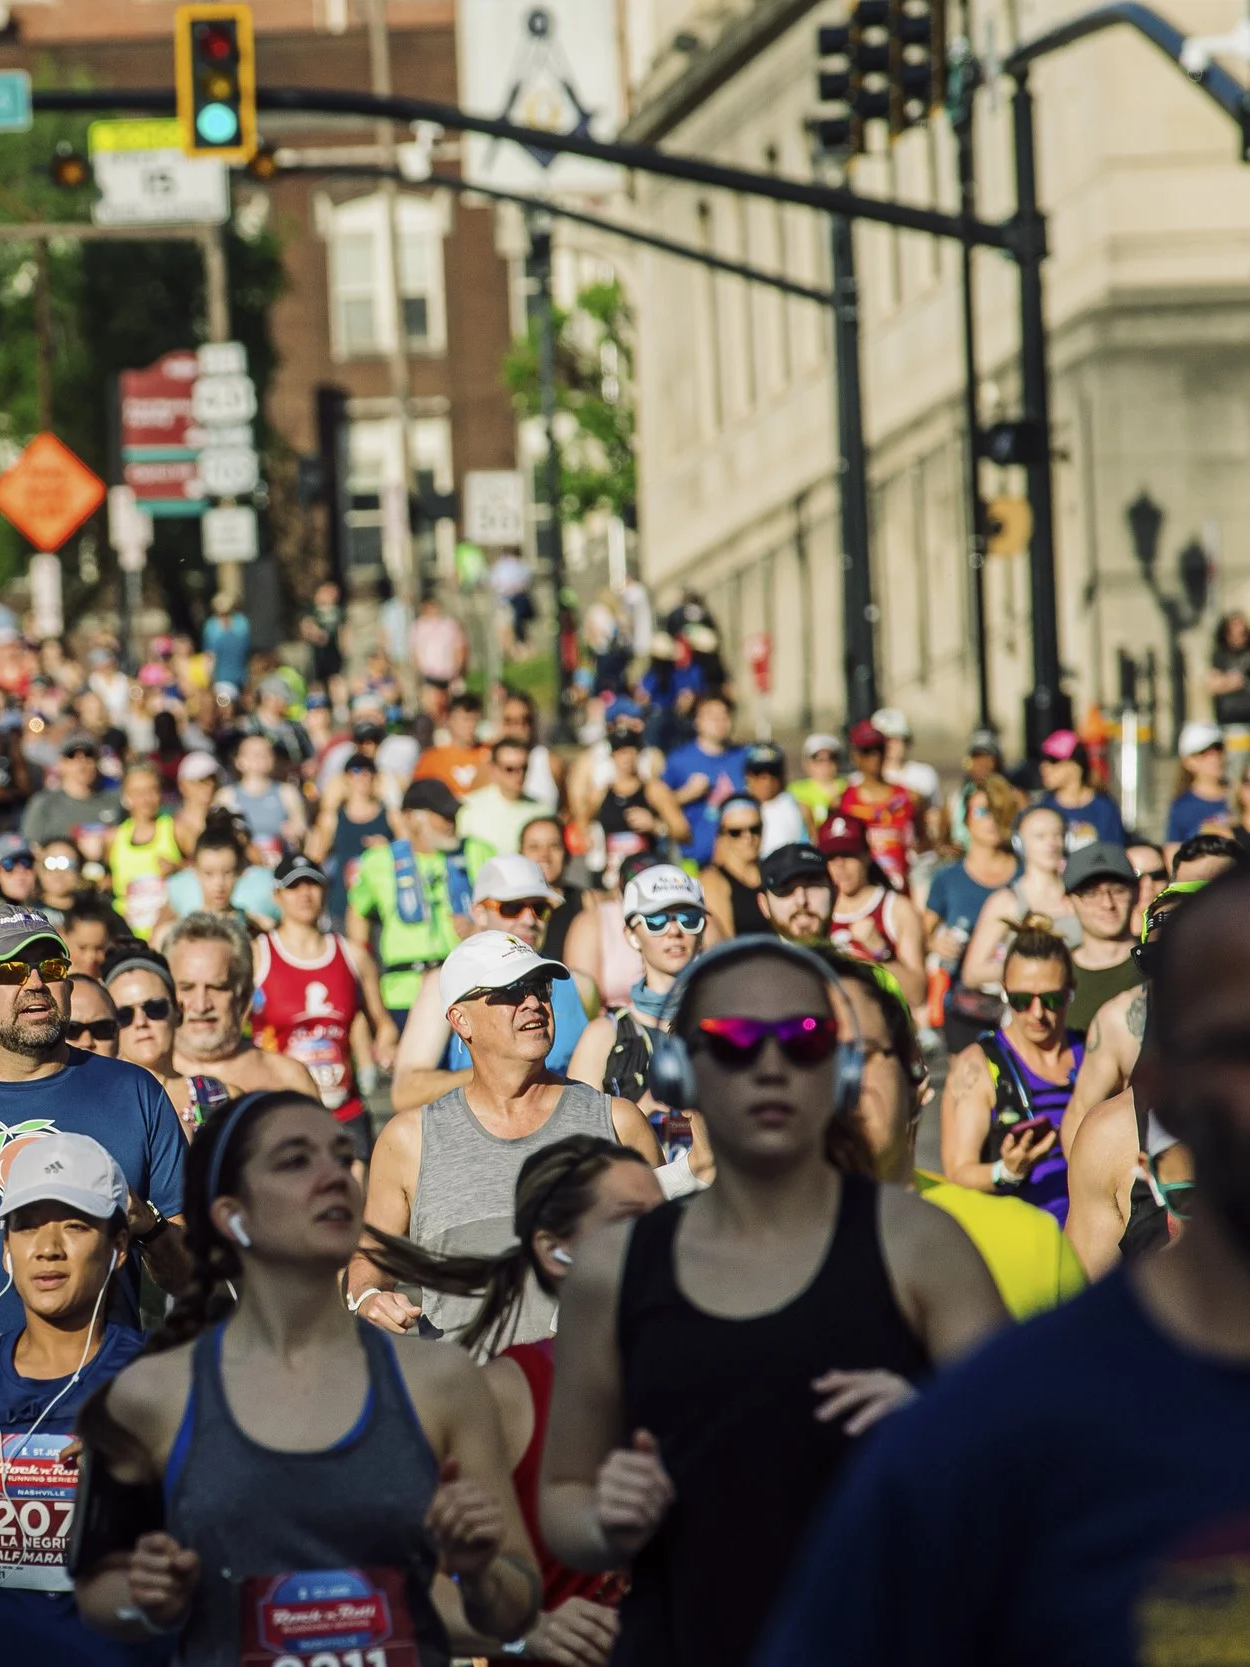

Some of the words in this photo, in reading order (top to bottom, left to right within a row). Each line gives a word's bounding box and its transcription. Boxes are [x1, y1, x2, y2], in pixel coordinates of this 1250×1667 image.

[17, 1489, 66, 1497] NASHVILLE
[0, 1536, 18, 1548] LA
[23, 1537, 70, 1549] NEGRI
[23, 1552, 66, 1564] MARA
